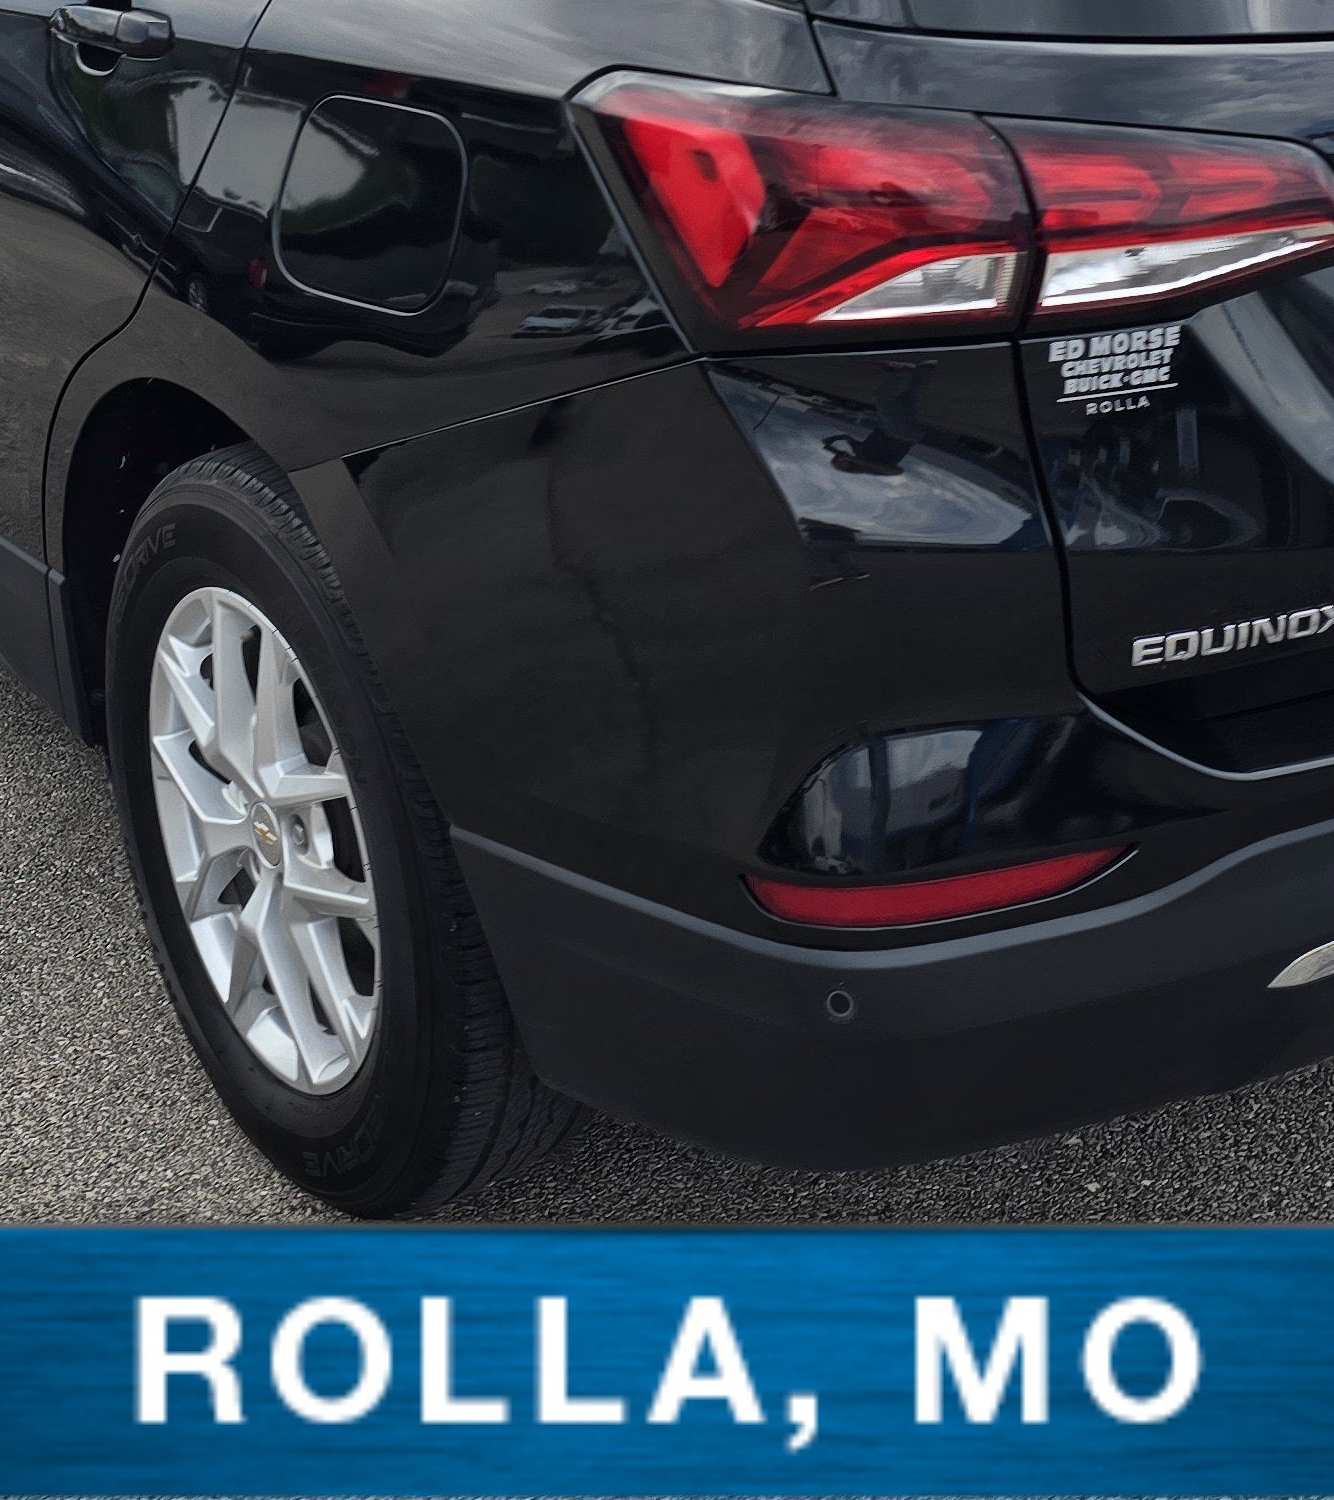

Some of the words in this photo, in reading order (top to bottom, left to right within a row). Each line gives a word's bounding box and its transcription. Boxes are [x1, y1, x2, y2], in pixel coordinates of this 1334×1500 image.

[1048, 338, 1085, 363] ED
[1089, 325, 1182, 358] MORSE
[1061, 347, 1174, 378] CHEVROLET
[1085, 395, 1151, 416] ROLLA
